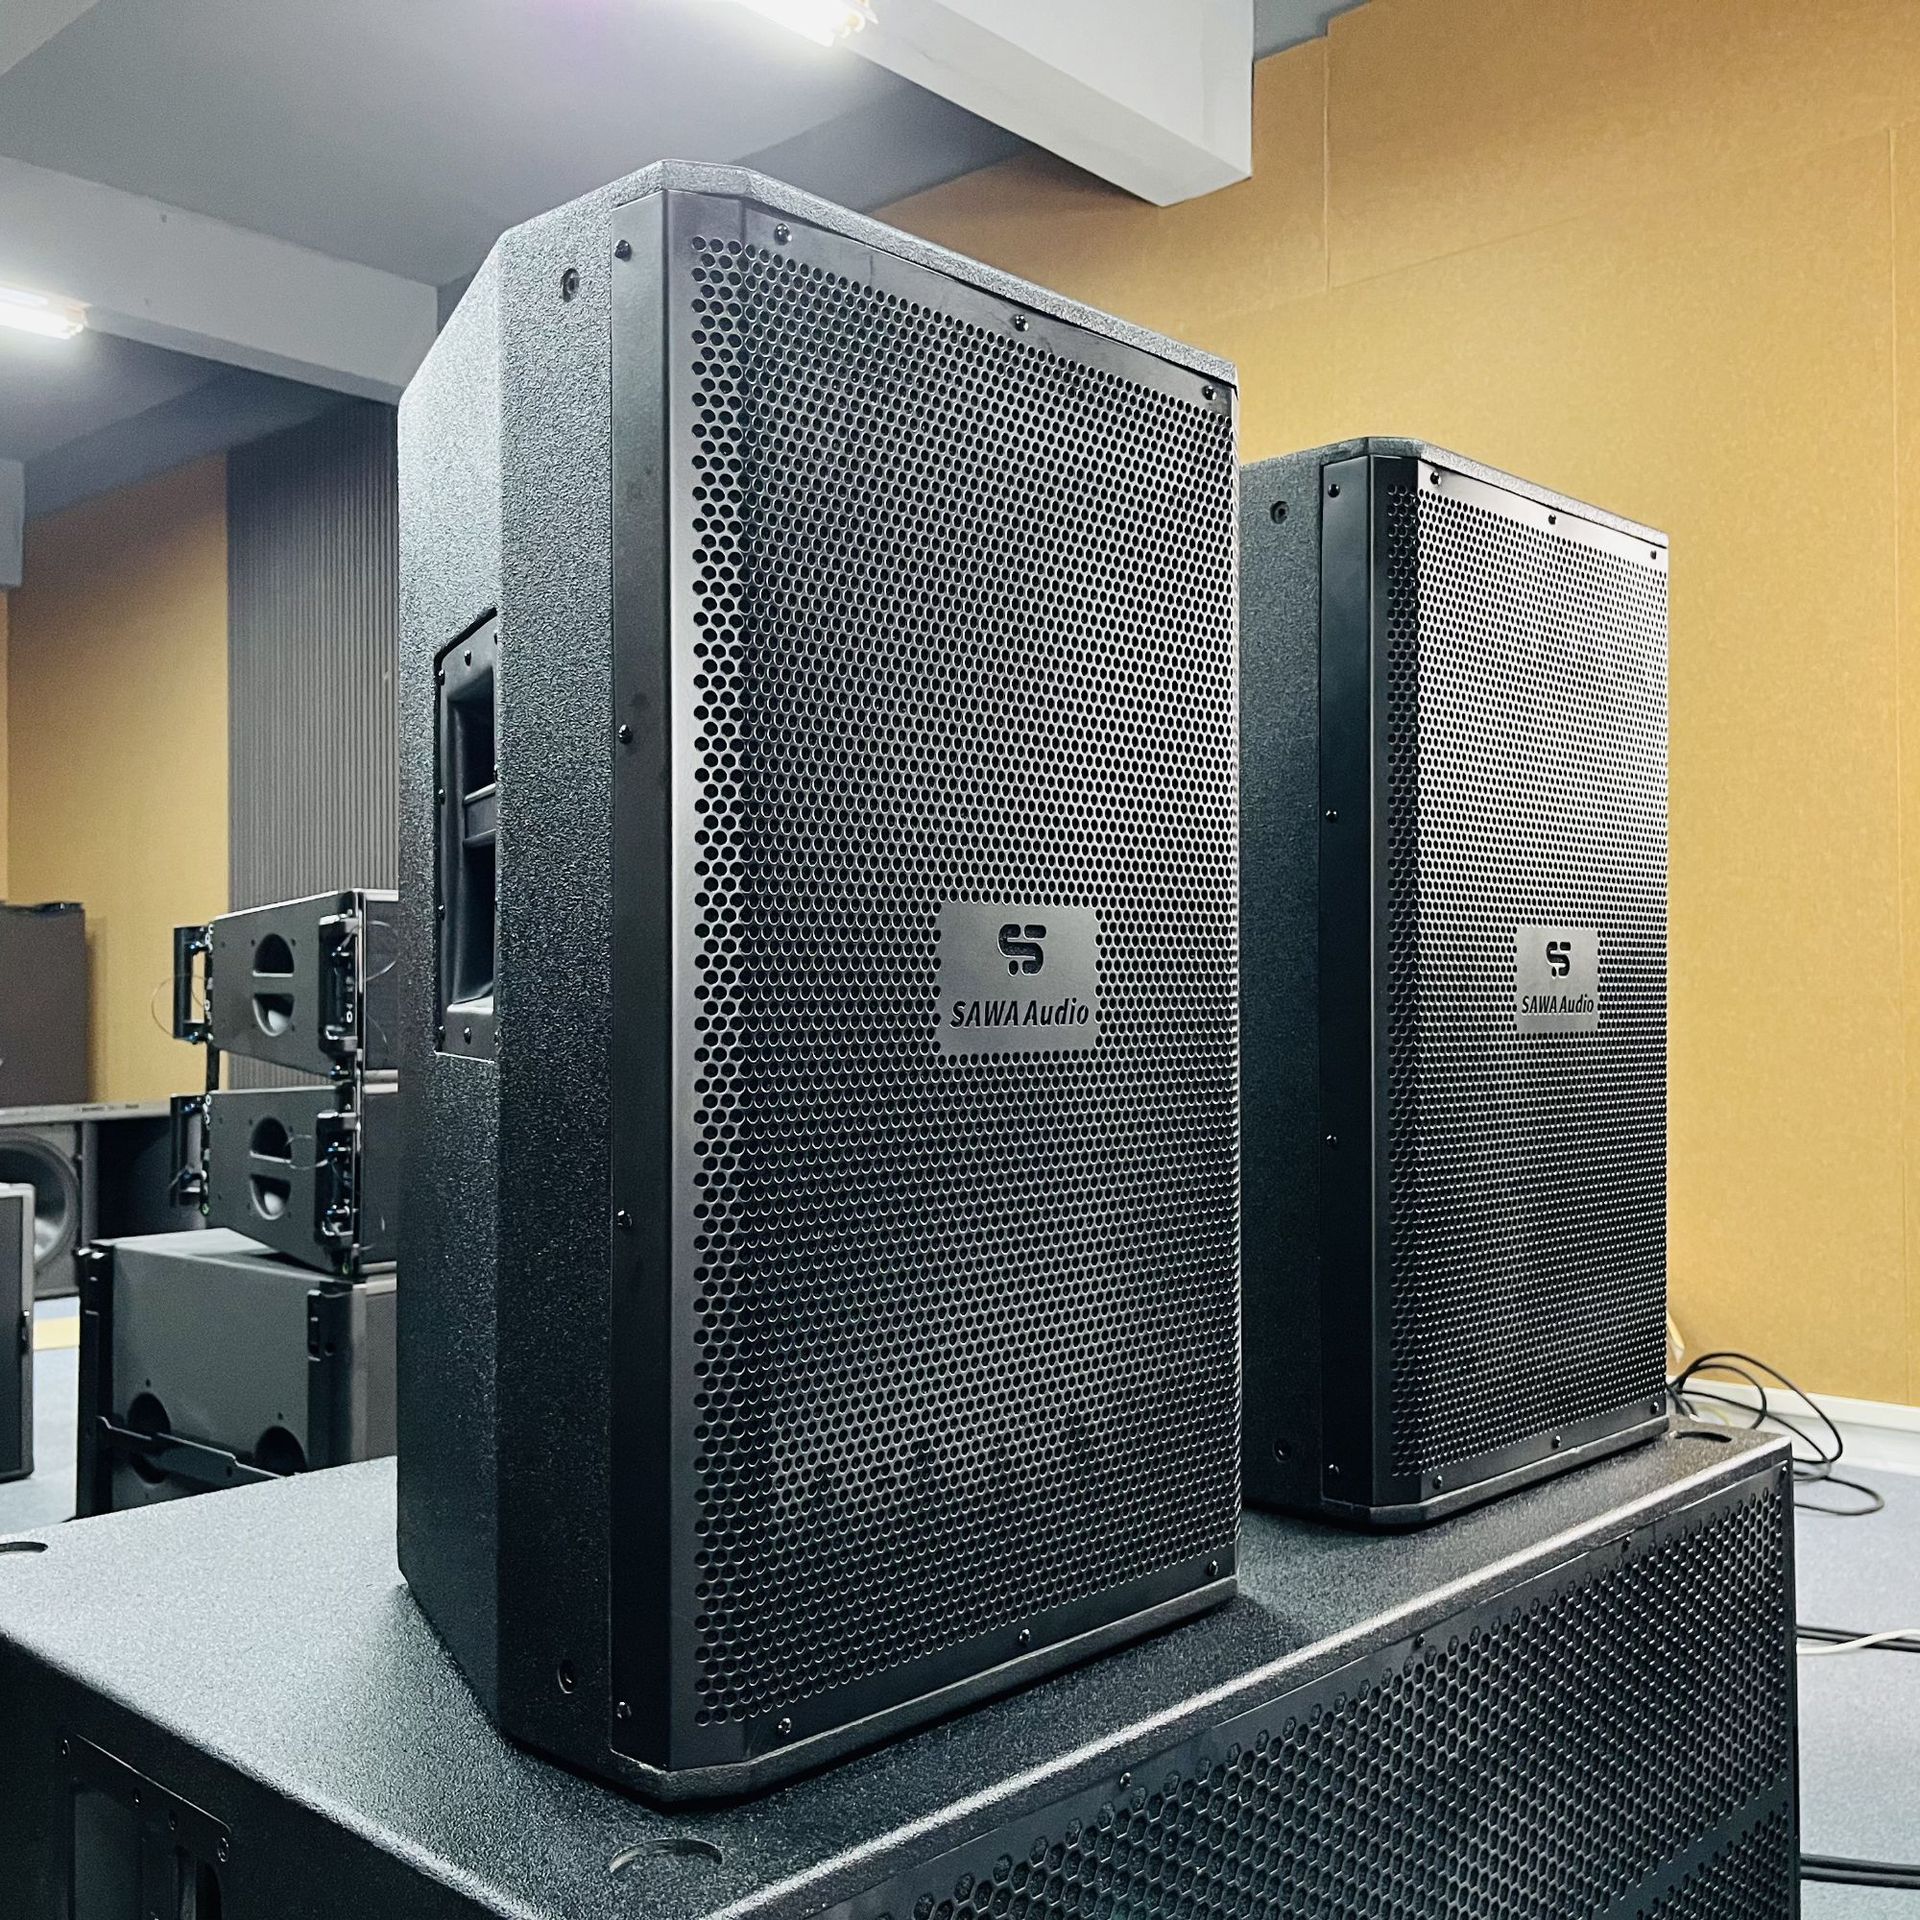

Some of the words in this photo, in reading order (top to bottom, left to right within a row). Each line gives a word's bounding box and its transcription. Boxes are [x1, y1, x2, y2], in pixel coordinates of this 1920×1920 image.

[950, 999, 1021, 1028] SAWA
[1022, 997, 1089, 1027] Audio
[1521, 995, 1557, 1014] SAWA
[1559, 993, 1594, 1013] Audio
